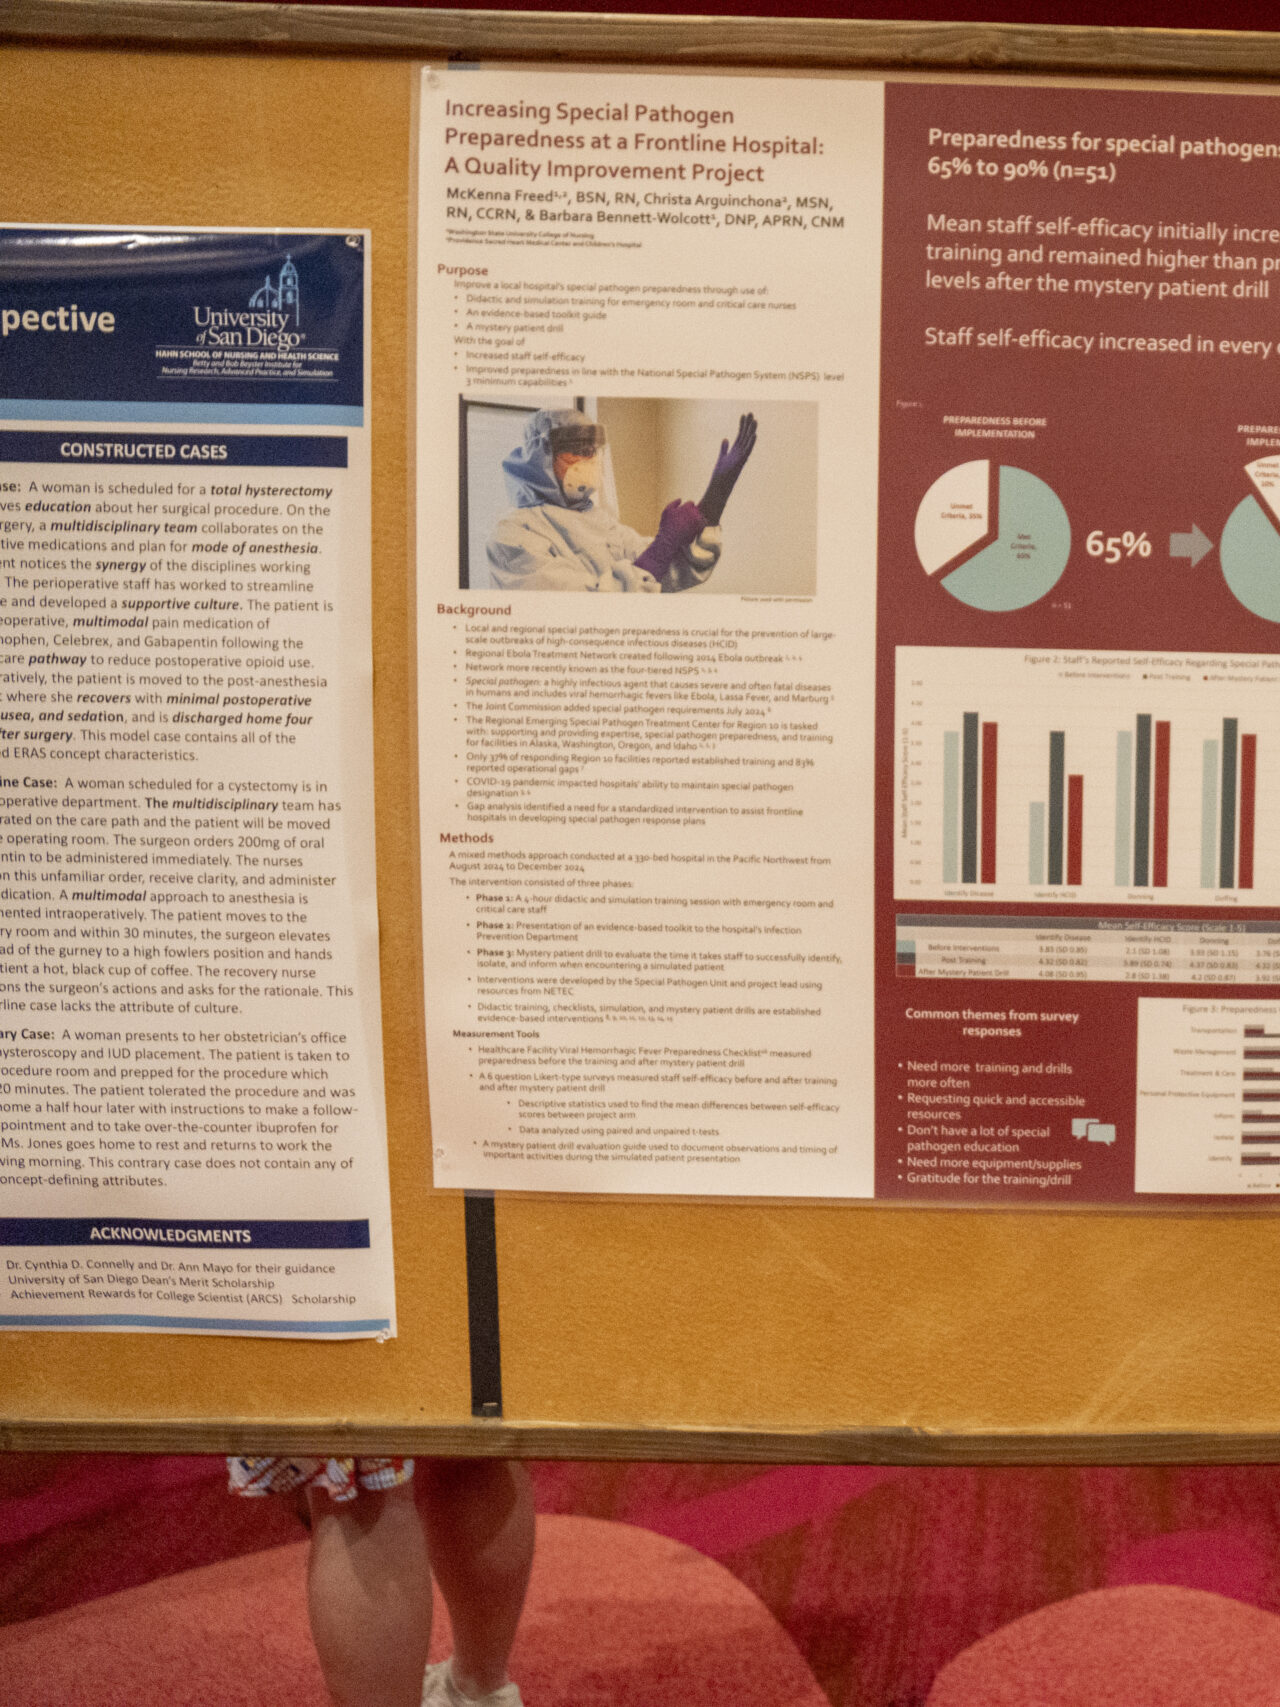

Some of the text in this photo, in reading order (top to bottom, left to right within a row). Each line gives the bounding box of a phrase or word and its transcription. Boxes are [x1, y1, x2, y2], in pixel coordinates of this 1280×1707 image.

[446, 99, 733, 128] Increasing Special Pathogen
[446, 127, 822, 158] Preparedness at a Frontline Hospital:
[929, 127, 1066, 152] Preparedness
[1071, 130, 1101, 151] for
[1106, 134, 1174, 157] special
[444, 156, 763, 186] A Quality Improvement Project
[928, 156, 1115, 184] 65% to 90% (n=51)
[446, 187, 510, 201] McKenna
[576, 191, 609, 206] BSN,
[615, 191, 639, 207] RN,
[644, 192, 691, 205] Christa
[796, 196, 832, 212] MSN,
[446, 206, 471, 222] RN,
[476, 207, 520, 223] CCRN,
[525, 208, 534, 221] &
[539, 209, 592, 222] Barbara
[725, 213, 757, 228] DNP,
[762, 214, 806, 230] APRN,
[811, 215, 844, 227] CNM
[437, 263, 488, 278] Purpose
[2, 304, 114, 336] pective
[194, 306, 289, 331] University
[196, 330, 206, 344] of
[208, 327, 242, 345] San
[943, 415, 1046, 426] PREPAREDNESS BEFORE
[954, 428, 1034, 438] IMPLEMENTATION
[60, 442, 227, 459] CONSTRUCTED CASES
[29, 480, 37, 492] A
[42, 483, 90, 493] woman
[94, 483, 103, 493] is
[108, 482, 172, 494] scheduled
[177, 482, 194, 494] for
[199, 486, 205, 495] a
[210, 483, 241, 496] total
[245, 483, 332, 499] hysterectomy
[1086, 530, 1151, 563] 65%
[437, 603, 511, 618] Background
[440, 832, 493, 843] Methods
[905, 1007, 1078, 1024] Common themes from survey
[962, 1027, 1021, 1038] responses
[90, 1226, 251, 1243] ACKNOWLEDGMENTS
[6, 1259, 335, 1276] Dr. Cynthia D. Connelly and Dr. Ann Mayo for their guidance
[10, 1288, 356, 1305] Achievement Rewards for College Scientist (ARCS) Scholarship
